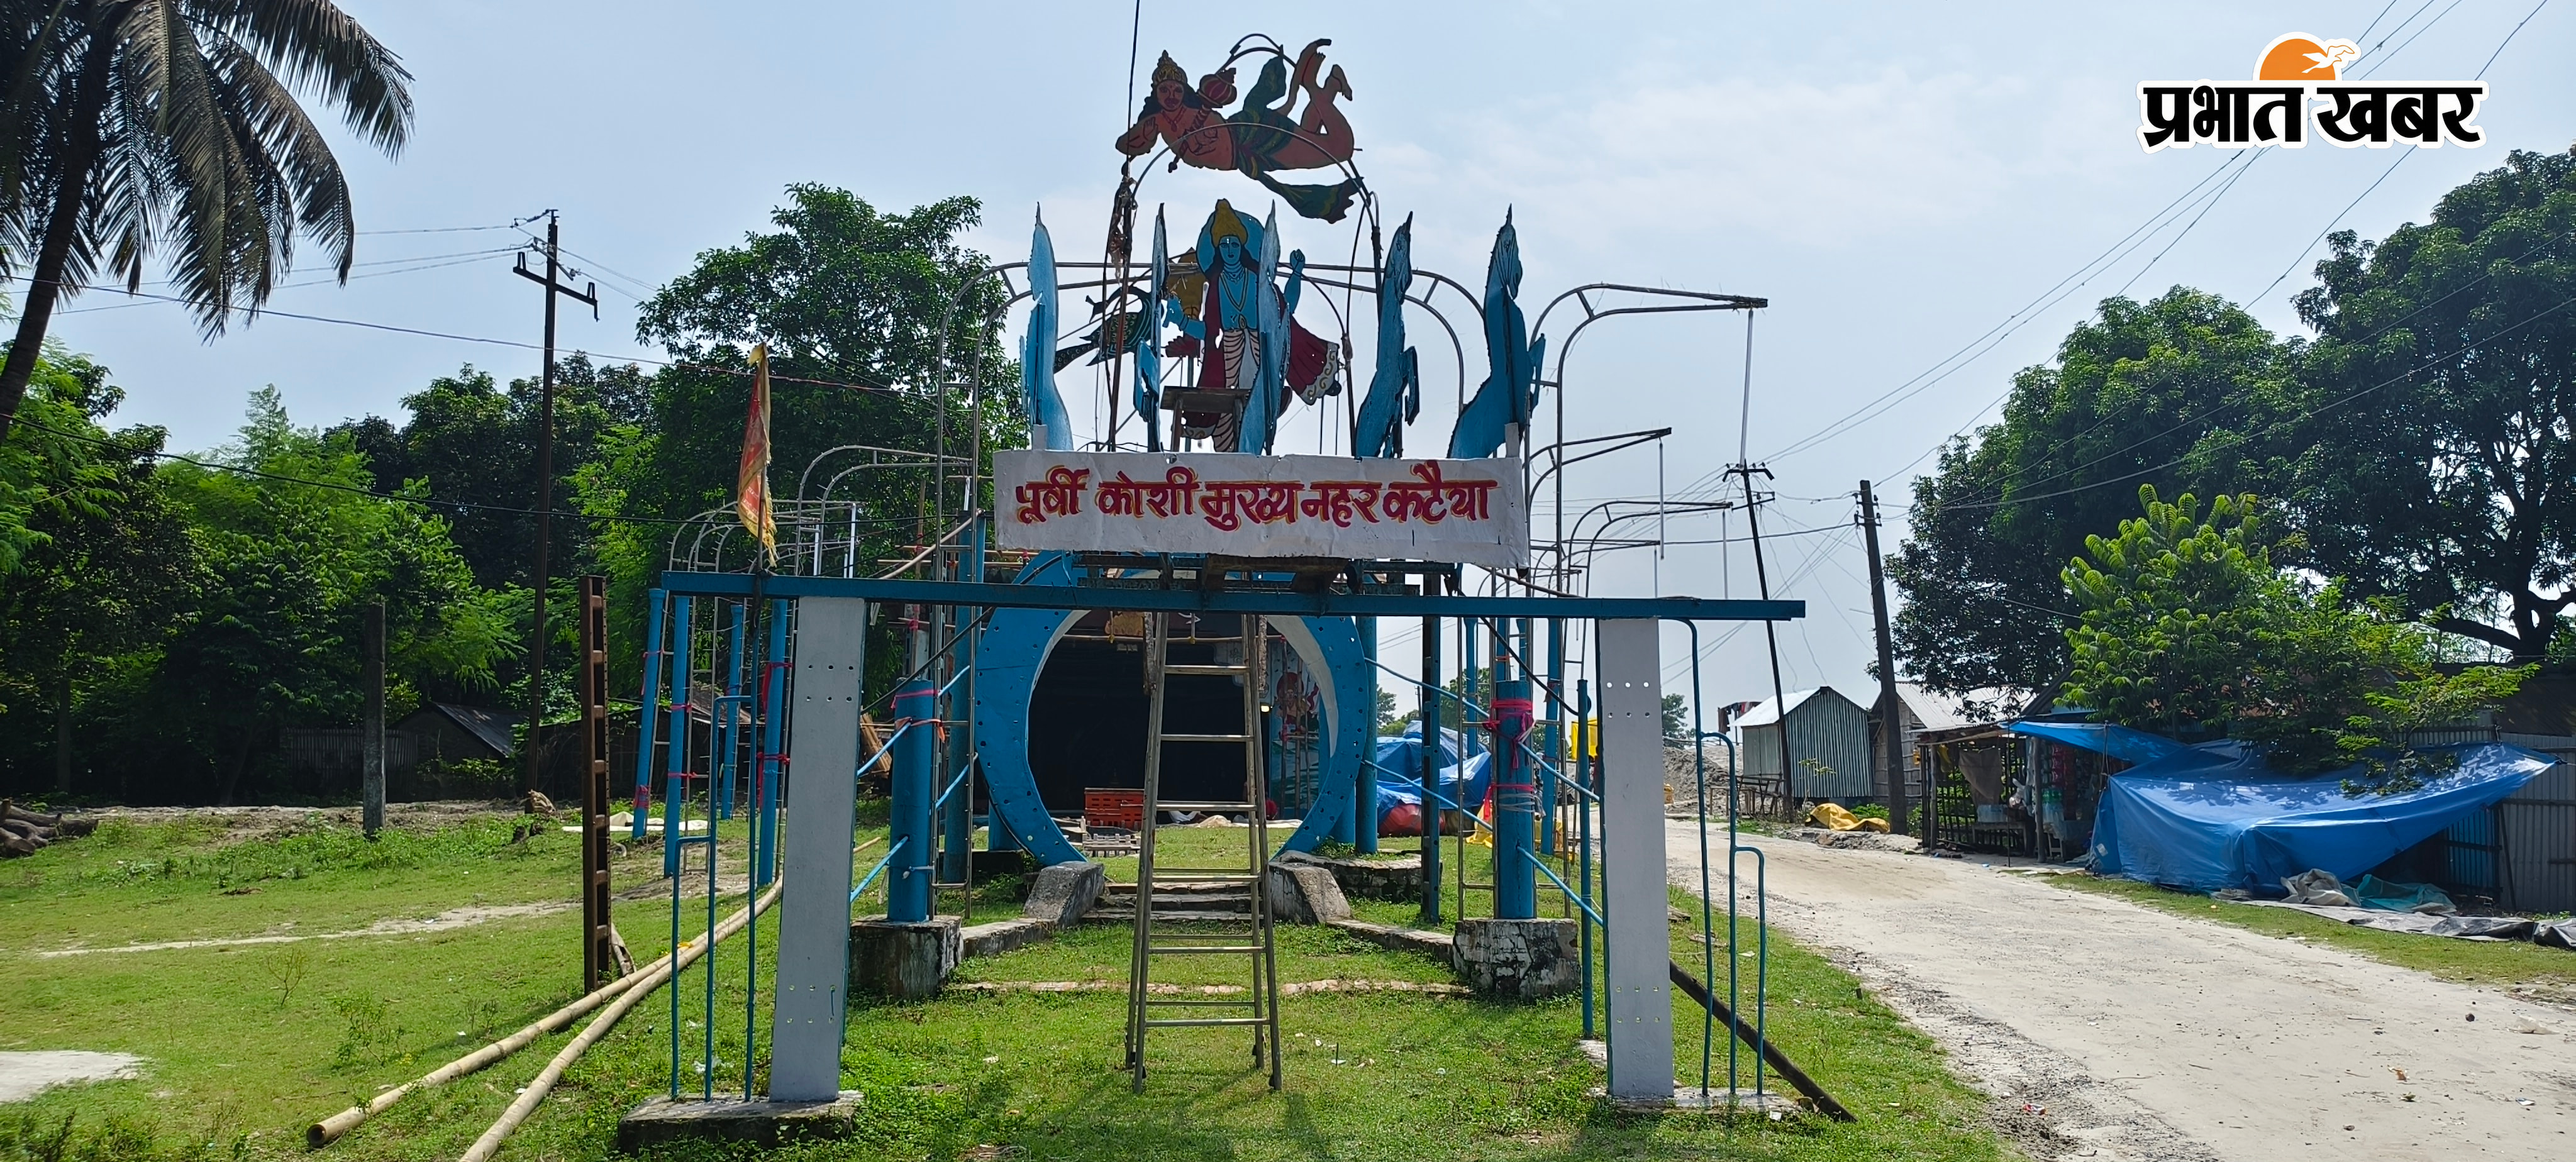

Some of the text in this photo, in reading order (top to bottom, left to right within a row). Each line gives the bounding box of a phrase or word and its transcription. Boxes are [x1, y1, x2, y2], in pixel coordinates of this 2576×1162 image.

[1016, 460, 1499, 531] पूर्वी कोशी मुख्य नहर कटैया
